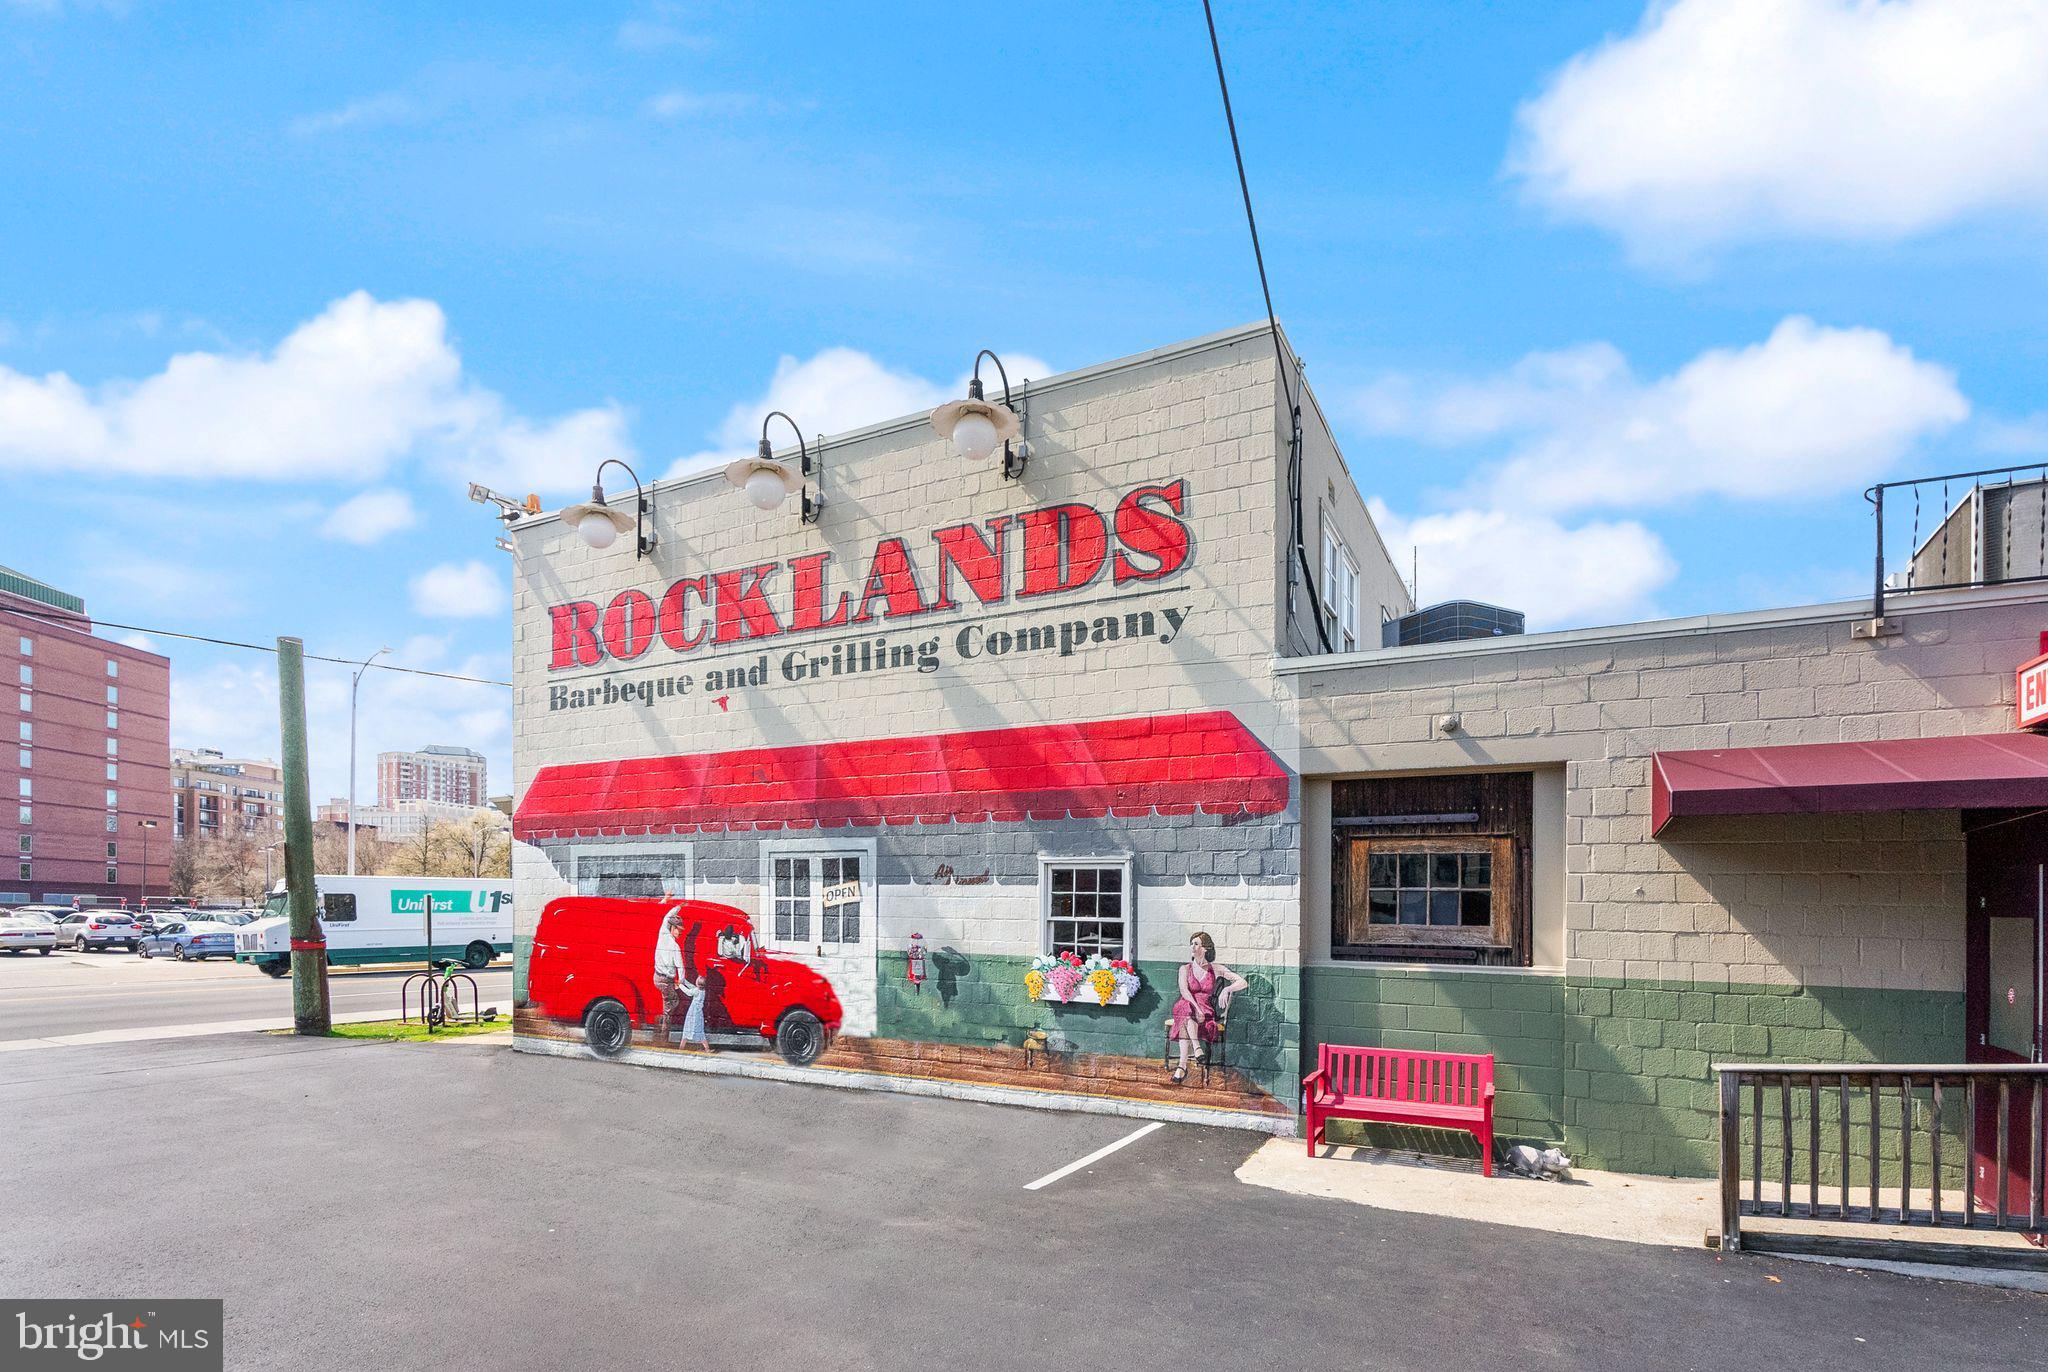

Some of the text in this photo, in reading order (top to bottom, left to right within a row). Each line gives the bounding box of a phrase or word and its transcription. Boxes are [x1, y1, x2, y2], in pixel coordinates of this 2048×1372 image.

[547, 477, 1197, 673] ROCKLANDS
[548, 605, 1194, 711] Barbeque and Grilling Company
[2026, 667, 2048, 711] EN
[398, 897, 453, 911] Uniirst
[826, 885, 856, 902] OPEN
